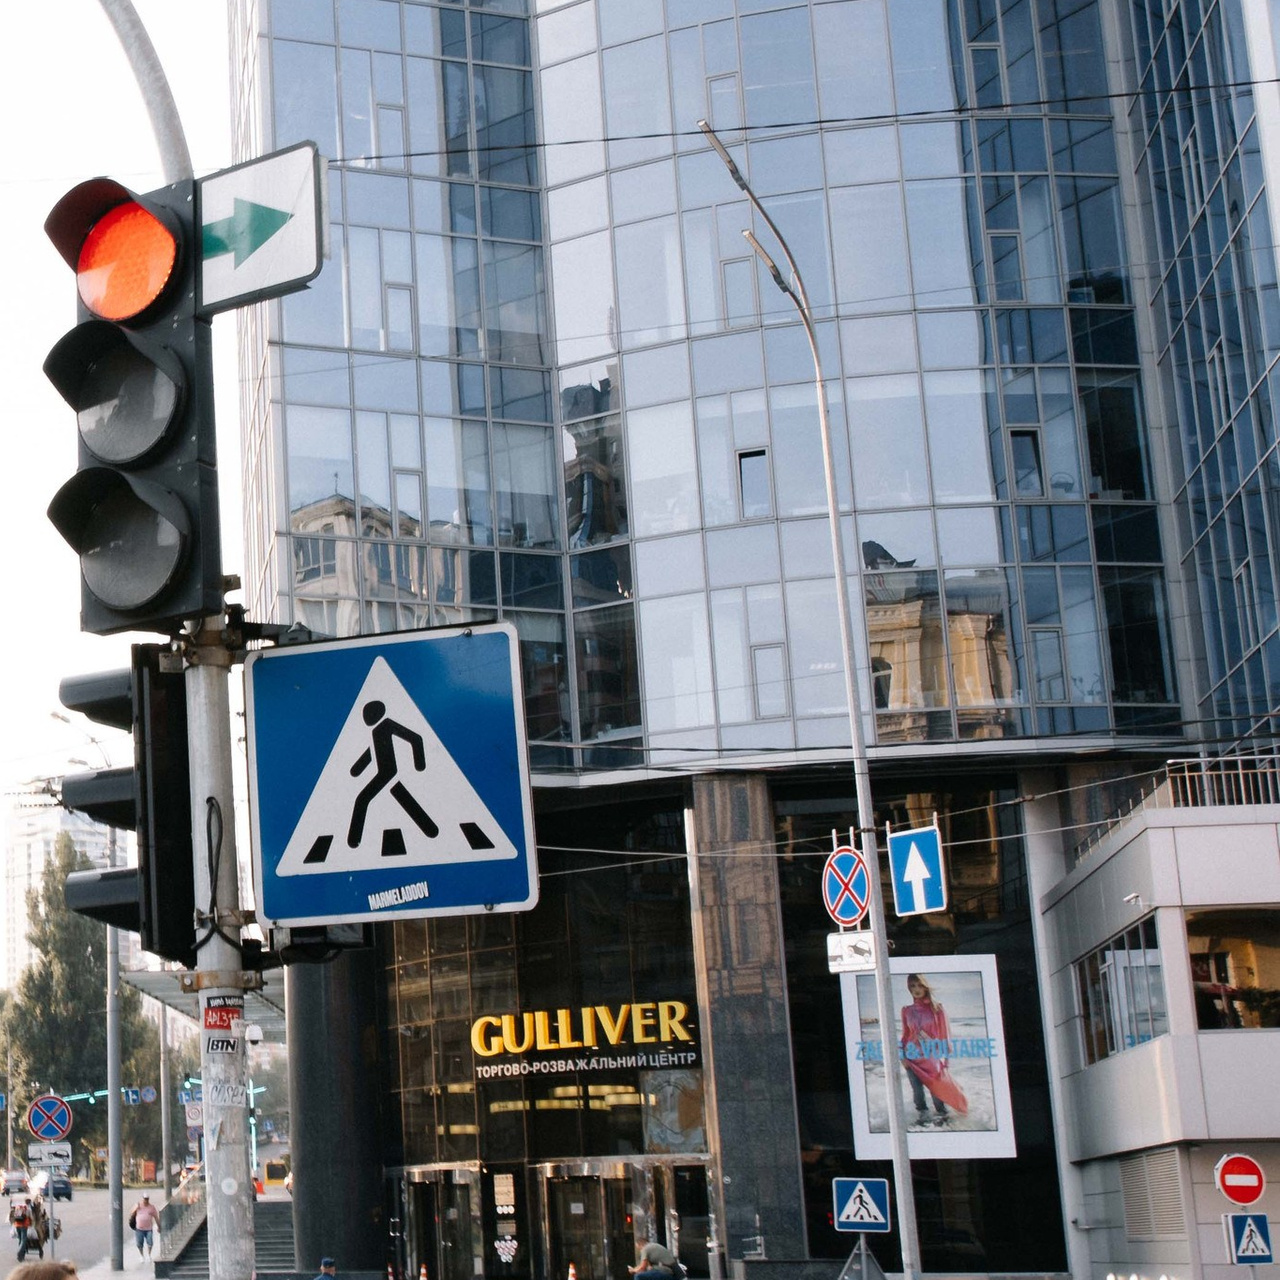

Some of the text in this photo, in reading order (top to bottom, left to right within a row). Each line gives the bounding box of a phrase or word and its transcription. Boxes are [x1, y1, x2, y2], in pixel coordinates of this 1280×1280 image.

[368, 881, 429, 911] MARMELADDOV
[471, 1001, 693, 1057] GULLIVER
[210, 1039, 237, 1052] BTN
[476, 1052, 697, 1078] ТОРГОВО-РОЗВАЖАЛЬНИЙ ЦЕНТР
